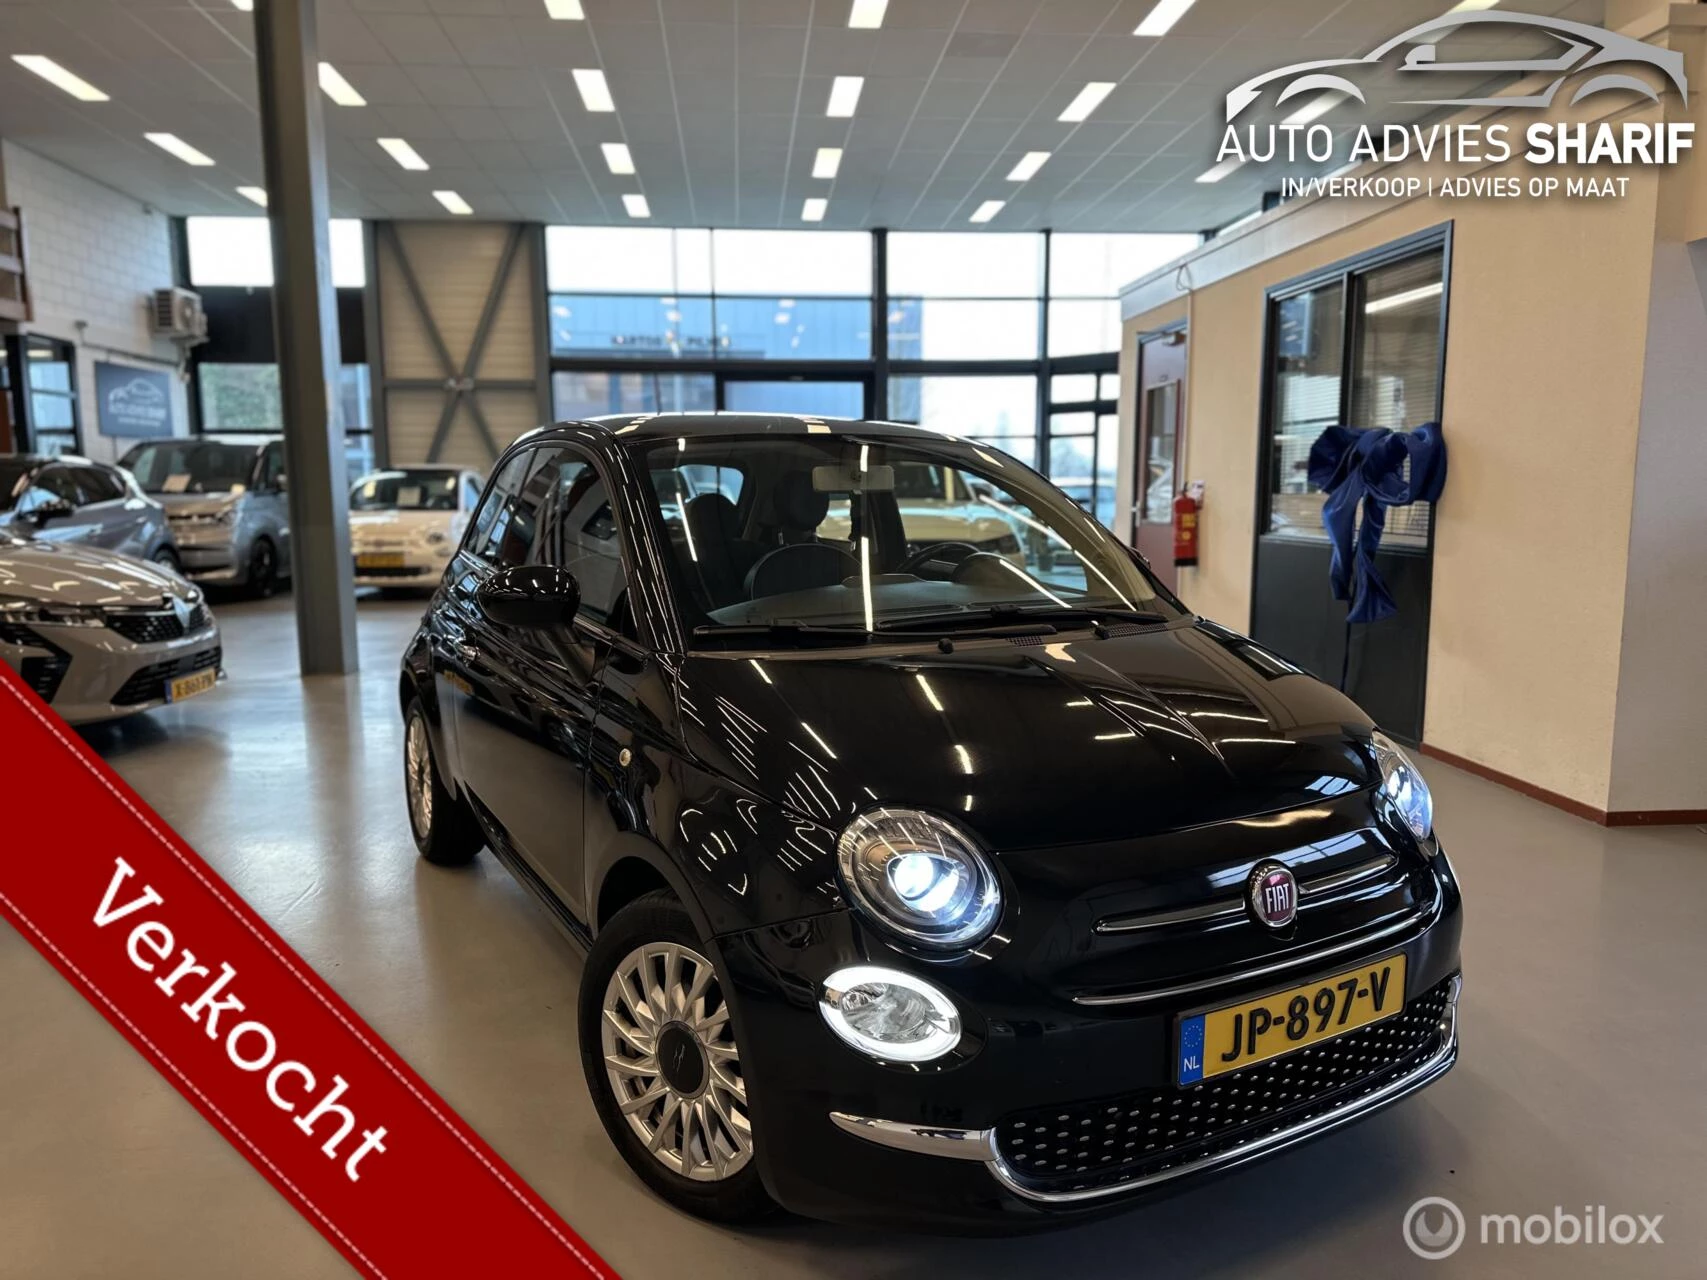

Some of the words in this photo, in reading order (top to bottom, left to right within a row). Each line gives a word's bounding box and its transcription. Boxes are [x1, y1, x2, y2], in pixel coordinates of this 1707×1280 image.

[1265, 883, 1289, 914] FIAT
[1221, 966, 1391, 1062] JP-897-V
[1183, 1055, 1200, 1073] NL
